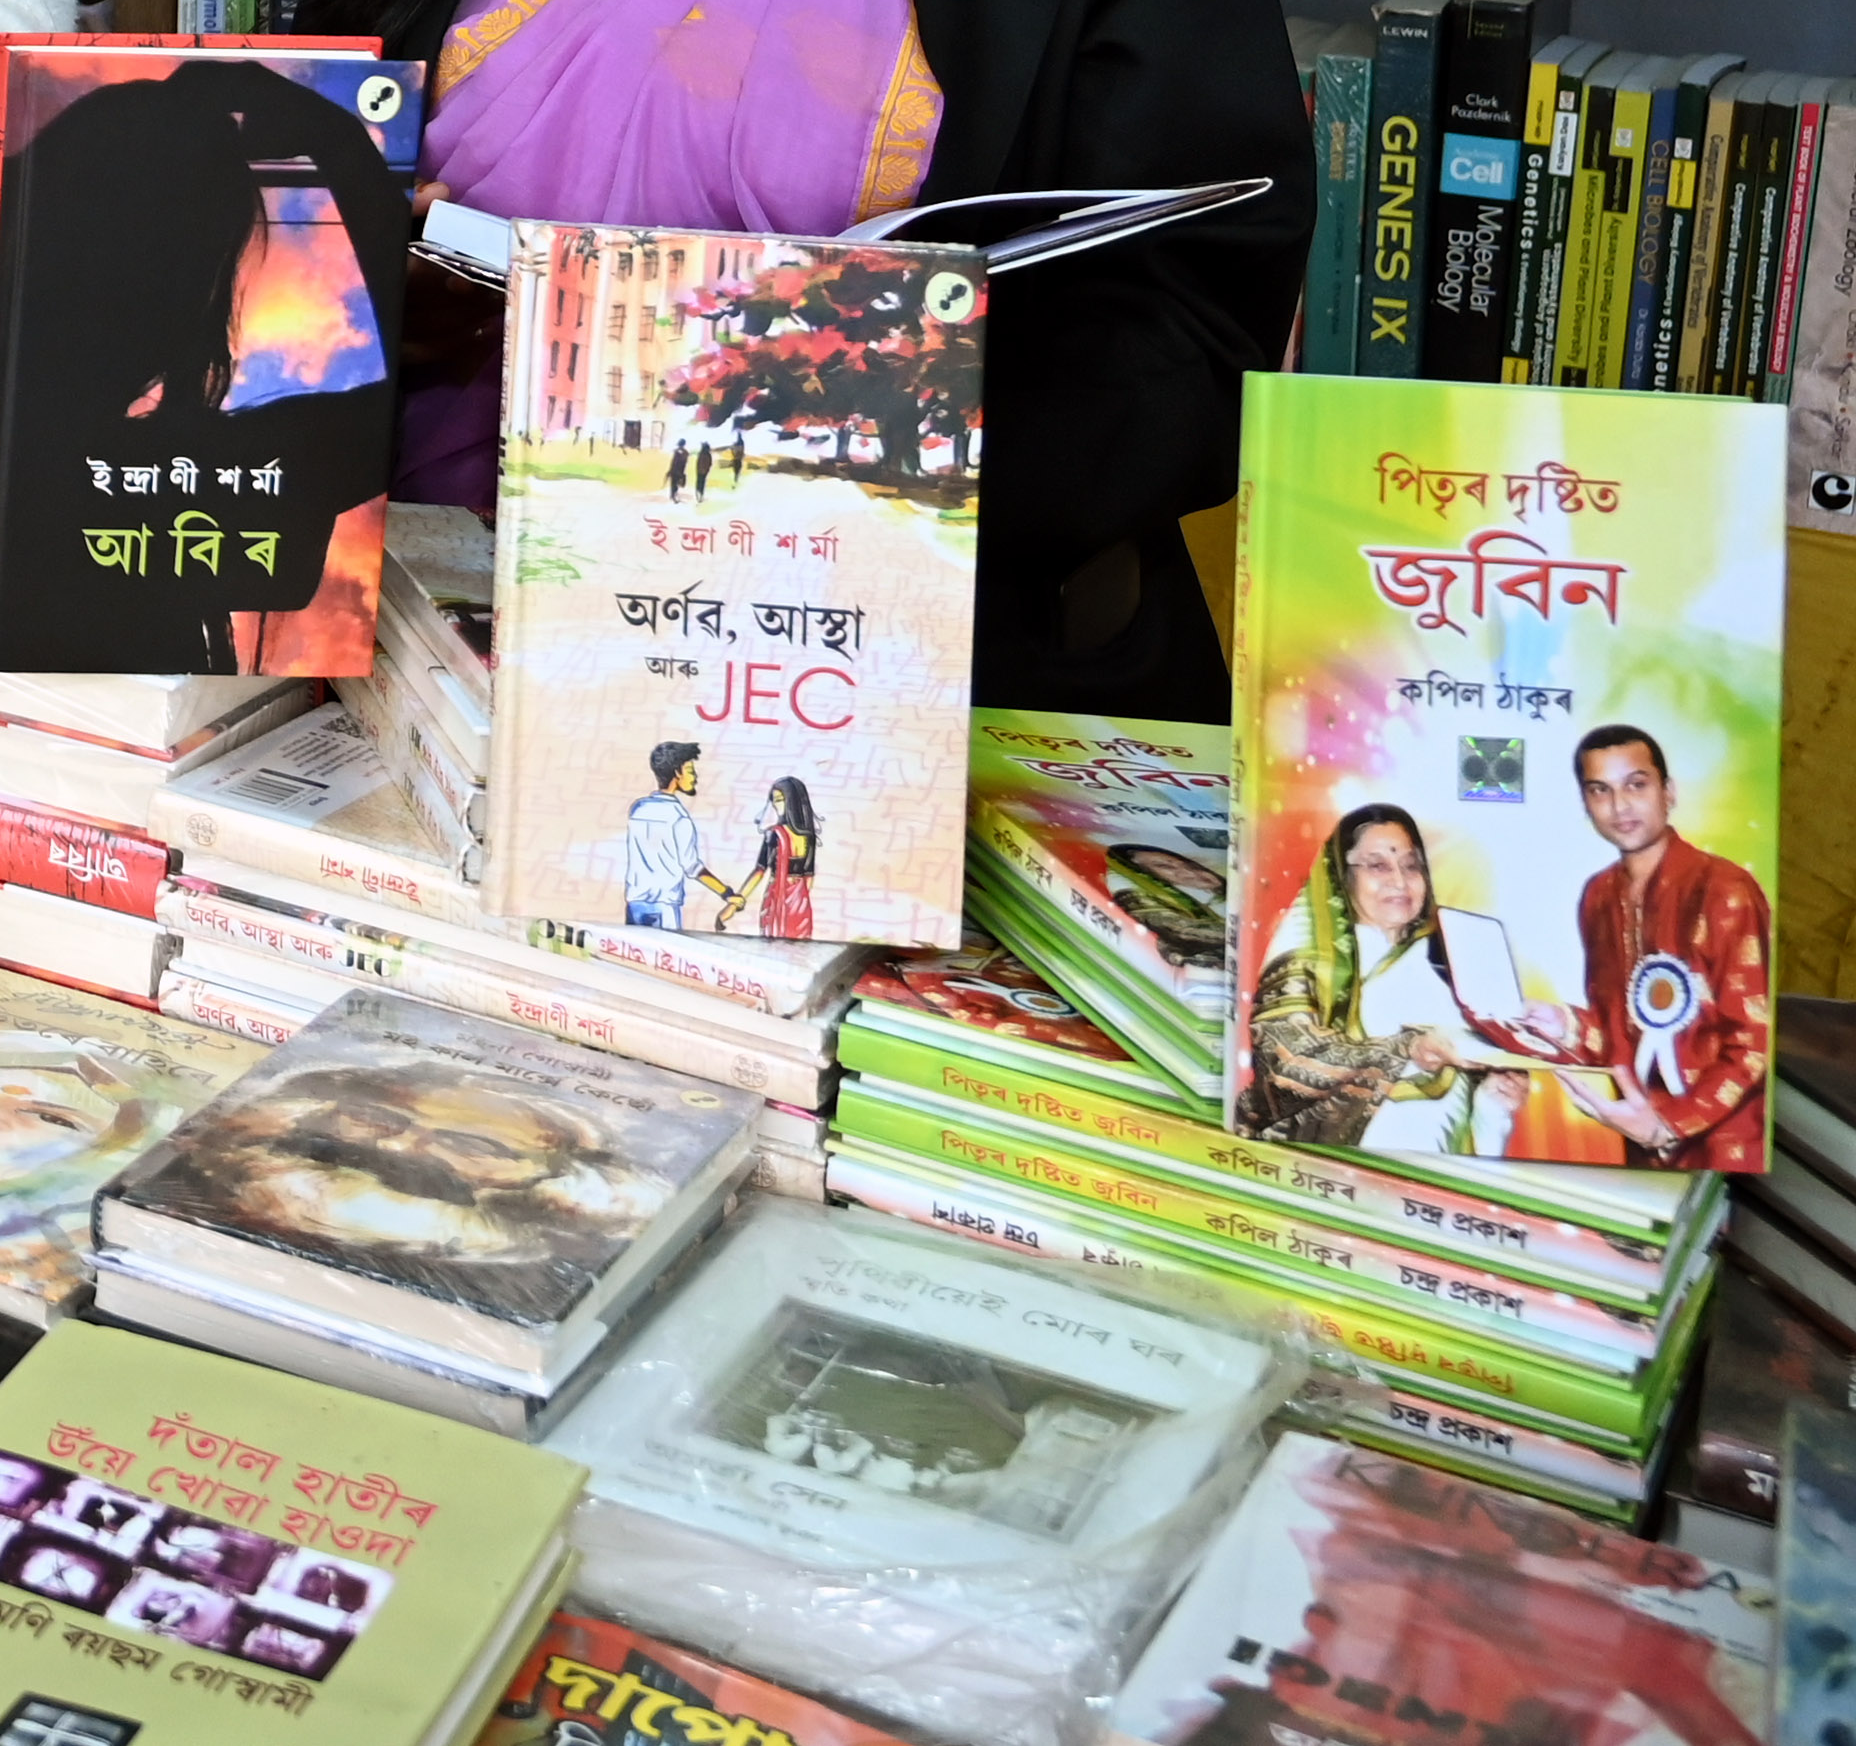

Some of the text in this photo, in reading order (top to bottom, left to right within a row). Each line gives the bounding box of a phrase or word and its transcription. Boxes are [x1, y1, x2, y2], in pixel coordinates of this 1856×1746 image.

[1382, 24, 1429, 39] LEWIN
[1451, 105, 1512, 125] Pazdernik
[1465, 93, 1499, 110] Clark
[1450, 157, 1504, 186] Cell
[1370, 114, 1418, 345] GENES IX
[1638, 140, 1670, 284] CELL BIOLOGY
[1436, 228, 1461, 315] Biology
[1469, 205, 1505, 318] Molecular
[1373, 453, 1621, 515] পিতৃৰ দৃষ্টিত
[82, 509, 283, 580] আবিৰ
[1363, 530, 1629, 638] জুবিন
[750, 600, 867, 662] আস্থা
[644, 654, 701, 681] আৰু
[694, 662, 858, 731] JEC
[1396, 672, 1573, 719] কপিল ঠাকুৰ
[46, 838, 129, 884] আবিৰ
[241, 917, 286, 952] আস্থা
[289, 930, 334, 963] আৰু
[338, 946, 394, 979] JEC
[943, 1066, 1007, 1103] পিতৃৰ
[1016, 1083, 1084, 1127] দৃষ্টিত
[1092, 1105, 1161, 1146] জুবিন
[1208, 1145, 1282, 1183] কপিল
[1288, 1160, 1357, 1206] ঠাকুৰ
[1453, 1207, 1529, 1250] প্ৰকাশ
[941, 1129, 1007, 1168] পিতৃৰ
[1014, 1149, 1082, 1194] দৃষ্টিত
[1089, 1171, 1158, 1213] জুবিন
[1205, 1210, 1279, 1250] কপিল
[1285, 1228, 1355, 1274] ঠাকুৰ
[1447, 1276, 1524, 1320] প্ৰকাশ
[1438, 1412, 1514, 1457] প্ৰকাশ
[146, 1411, 440, 1528] দঁতাল হাতীৰ
[280, 1501, 417, 1566] হাওদা
[169, 1658, 317, 1716] গোস্বামী
